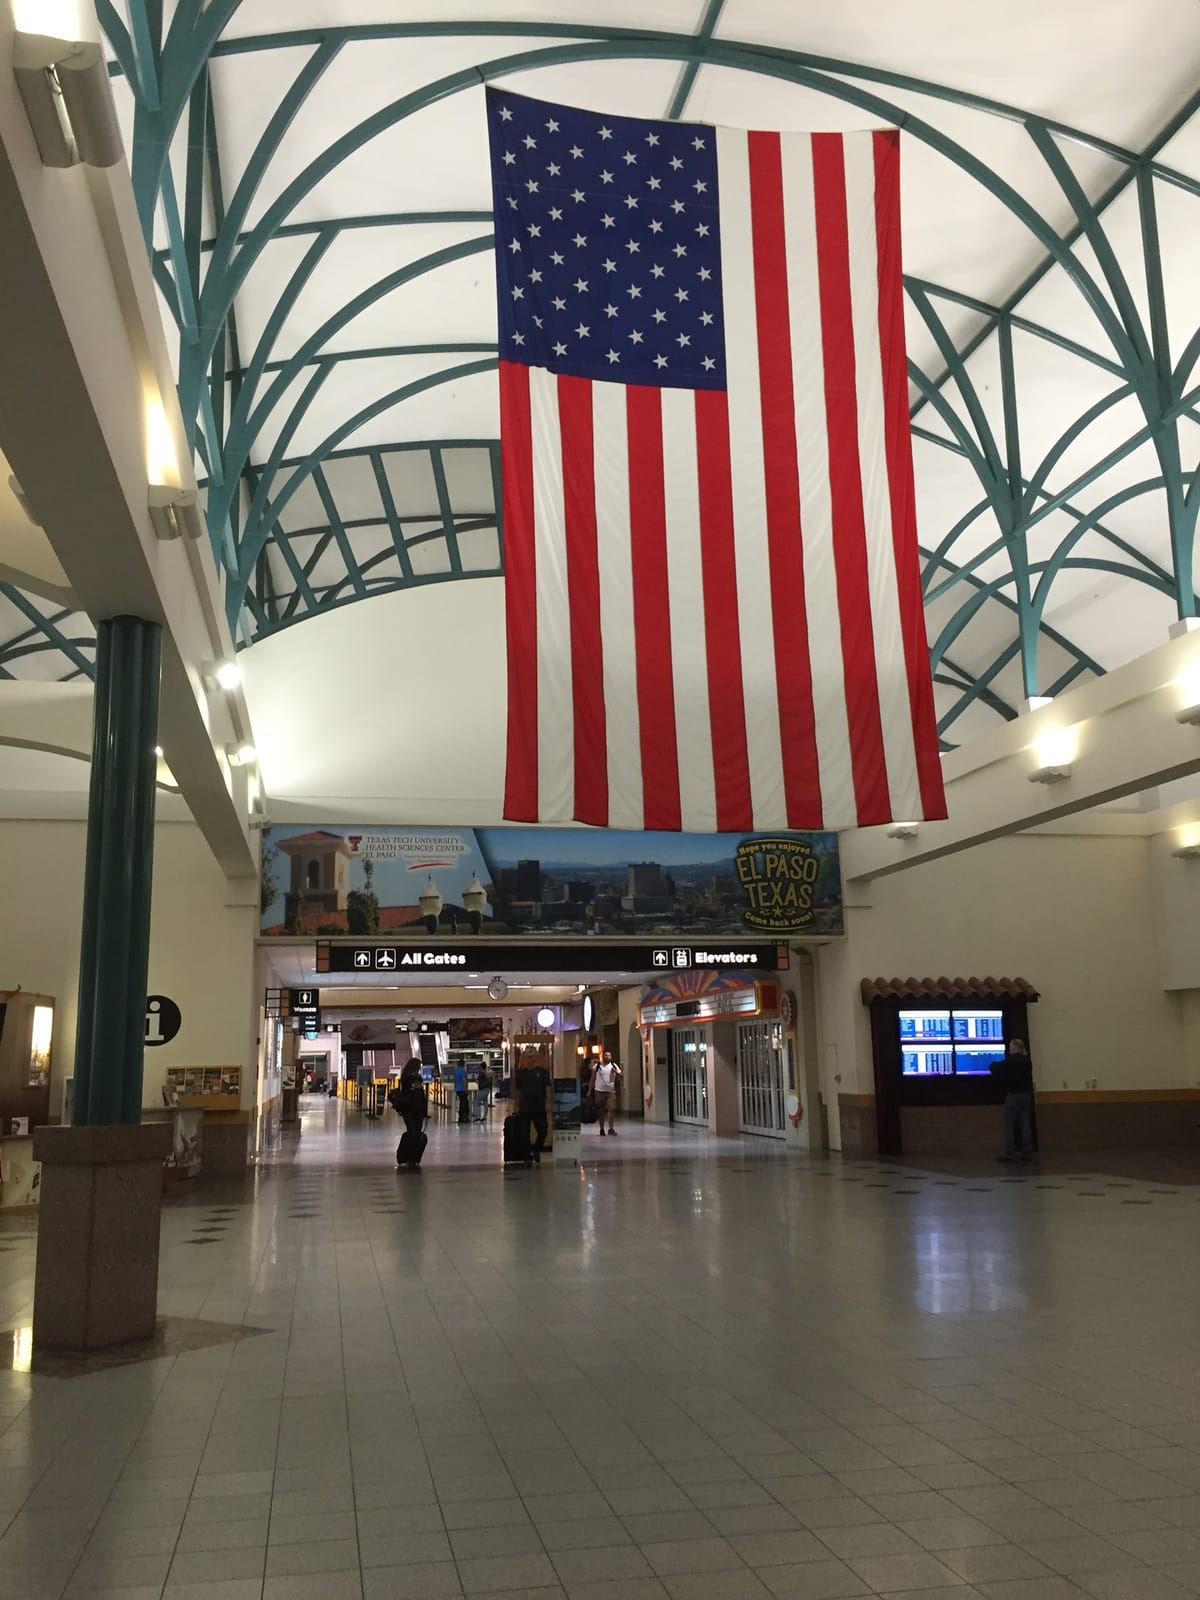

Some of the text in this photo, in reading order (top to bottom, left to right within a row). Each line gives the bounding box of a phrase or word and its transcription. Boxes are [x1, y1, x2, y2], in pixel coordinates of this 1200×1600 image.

[366, 836, 460, 844] TEXAS TECH UNIVERSITY
[366, 844, 465, 852] HEALTH SCIENCES CENTER
[739, 843, 811, 855] Hope you enjoyed
[736, 854, 818, 882] EL PASO
[744, 882, 812, 908] TEXAS
[745, 912, 813, 926] Come back soon!
[401, 952, 467, 965] All Gates
[695, 951, 758, 964] Elevators
